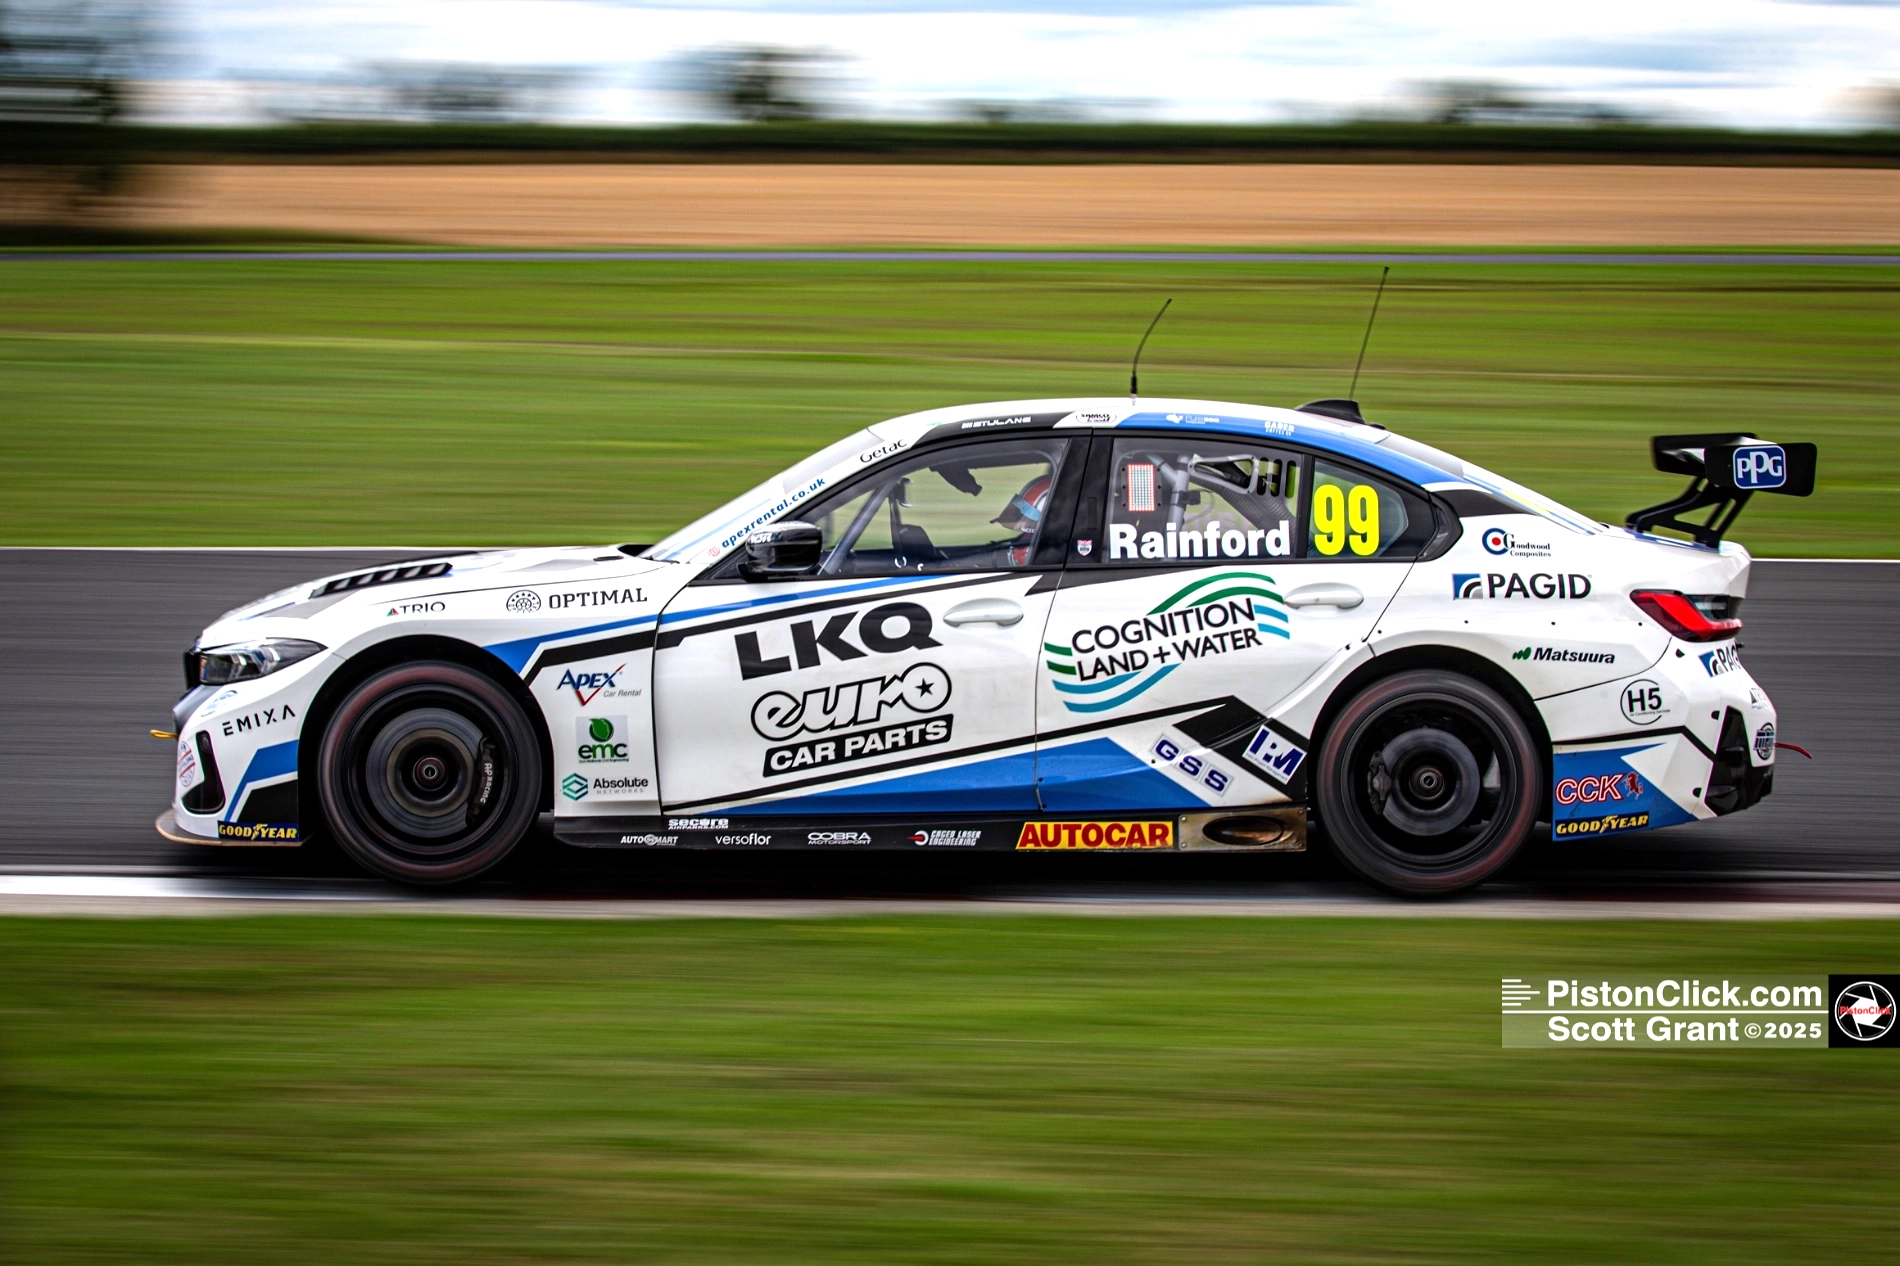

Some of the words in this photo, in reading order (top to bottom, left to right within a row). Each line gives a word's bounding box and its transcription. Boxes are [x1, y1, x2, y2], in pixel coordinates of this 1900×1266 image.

[859, 438, 908, 465] Getac
[1737, 450, 1784, 484] PPG
[721, 477, 826, 549] apexrental.co.uk
[1313, 484, 1380, 556] 99
[1109, 520, 1291, 560] Rainford
[1503, 533, 1551, 550] Goodwood
[1509, 550, 1552, 558] Composites
[1487, 572, 1592, 600] PAGID
[399, 601, 446, 614] TRIO
[548, 588, 648, 609] OPTIMAL
[1072, 598, 1256, 654] COGNITION
[734, 602, 944, 681] LKQ
[1532, 647, 1616, 664] Matsuura
[603, 689, 616, 698] Car
[617, 688, 642, 697] Rental
[751, 661, 953, 742] euro
[1626, 687, 1663, 713] H5
[222, 704, 297, 737] EMIXA
[577, 743, 628, 759] emc
[770, 742, 837, 772] CAR
[843, 720, 949, 758] PARTS
[1154, 738, 1230, 793] GSS
[593, 777, 649, 789] Absolute
[1555, 773, 1625, 806] CCK
[218, 824, 298, 840] GOODYEAR
[668, 818, 729, 826] secure
[1556, 815, 1649, 835] GOODYEAR
[715, 833, 772, 845] versoflor
[807, 832, 872, 840] COBRA
[928, 838, 977, 846] ENGINEERING
[957, 830, 982, 839] LASER
[1018, 822, 1170, 848] AUTOCAR
